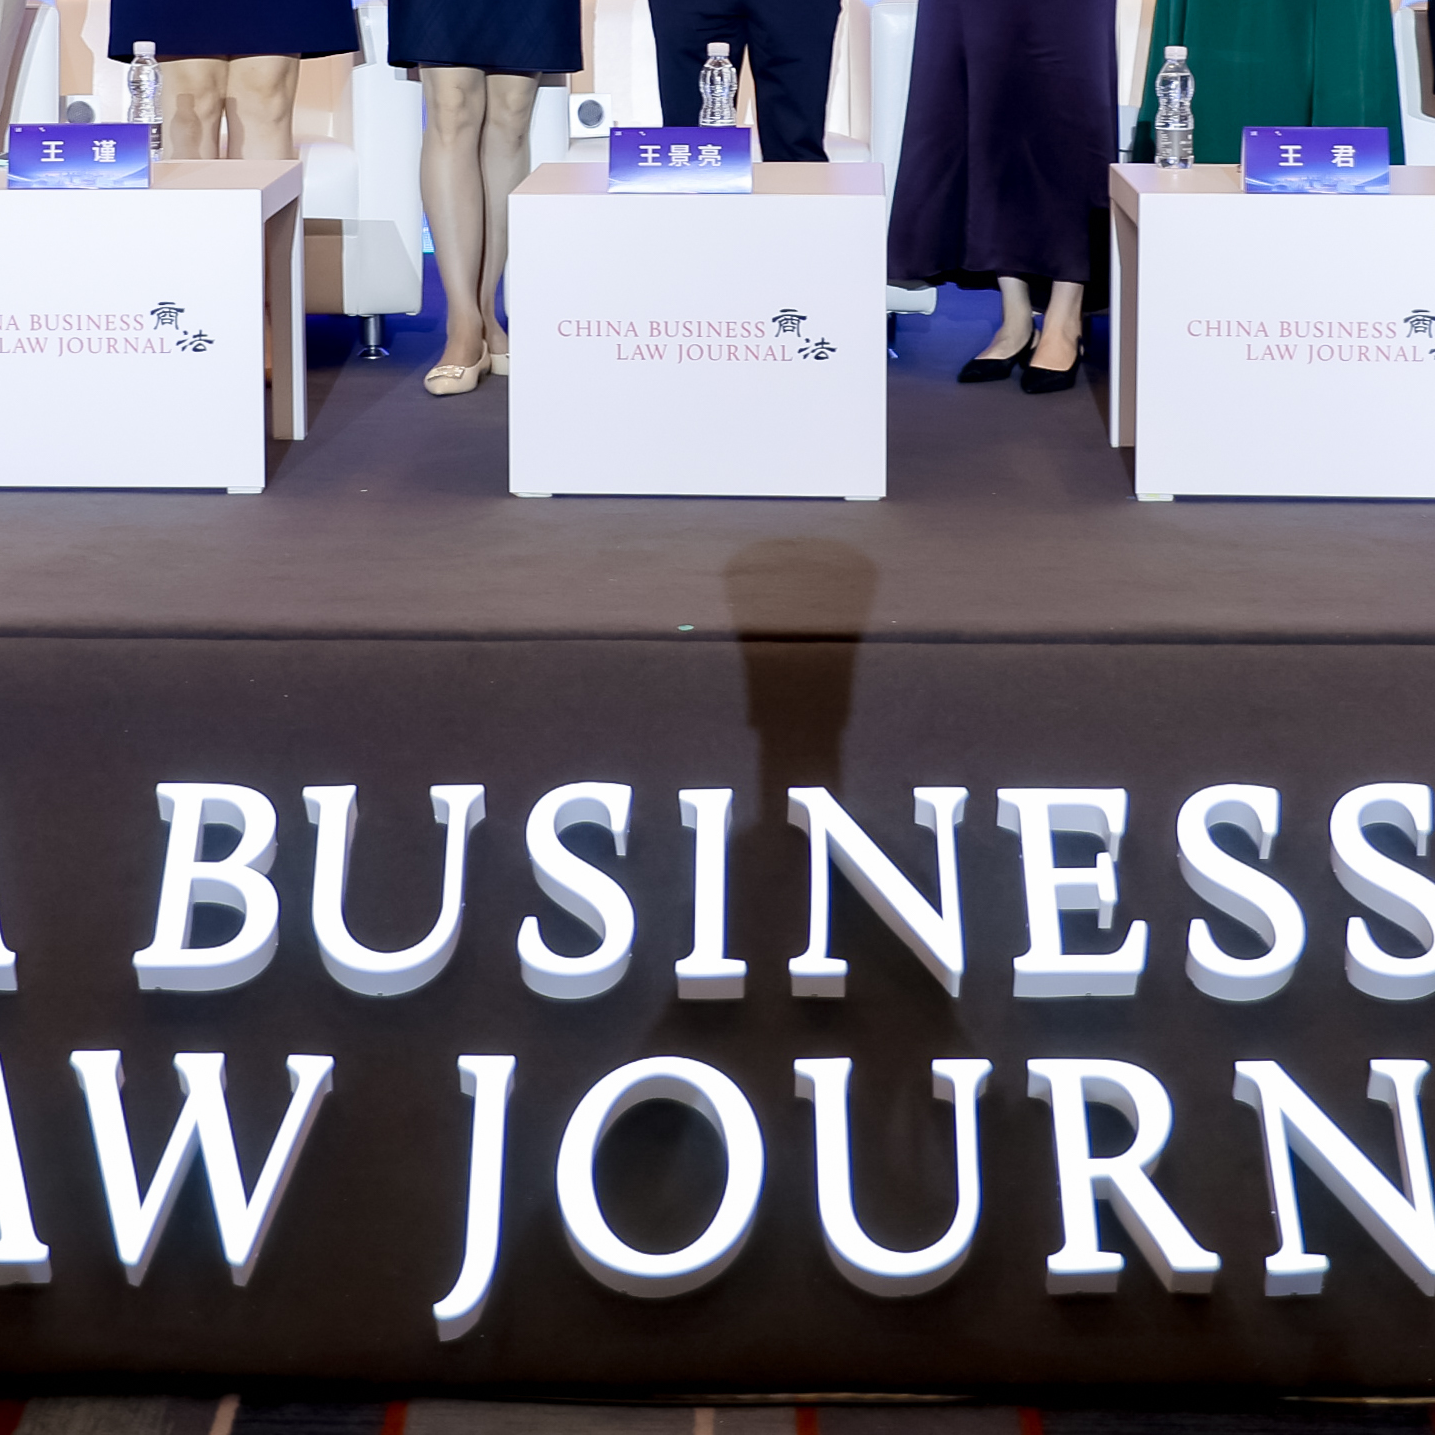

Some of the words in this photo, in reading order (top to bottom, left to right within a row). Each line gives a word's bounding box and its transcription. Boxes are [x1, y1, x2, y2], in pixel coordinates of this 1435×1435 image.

[638, 144, 722, 167] 王景亮
[30, 314, 144, 331] BUSINESS
[557, 320, 639, 338] CHINA
[649, 320, 765, 338] BUSINESS
[1187, 320, 1269, 338] CHINA
[1279, 320, 1397, 339] BUSINESS
[58, 337, 172, 357] JOURNAL
[616, 344, 668, 361] LAW
[678, 344, 793, 364] JOURNAL
[1246, 344, 1298, 361] LAW
[1307, 344, 1424, 364] JOURNAL
